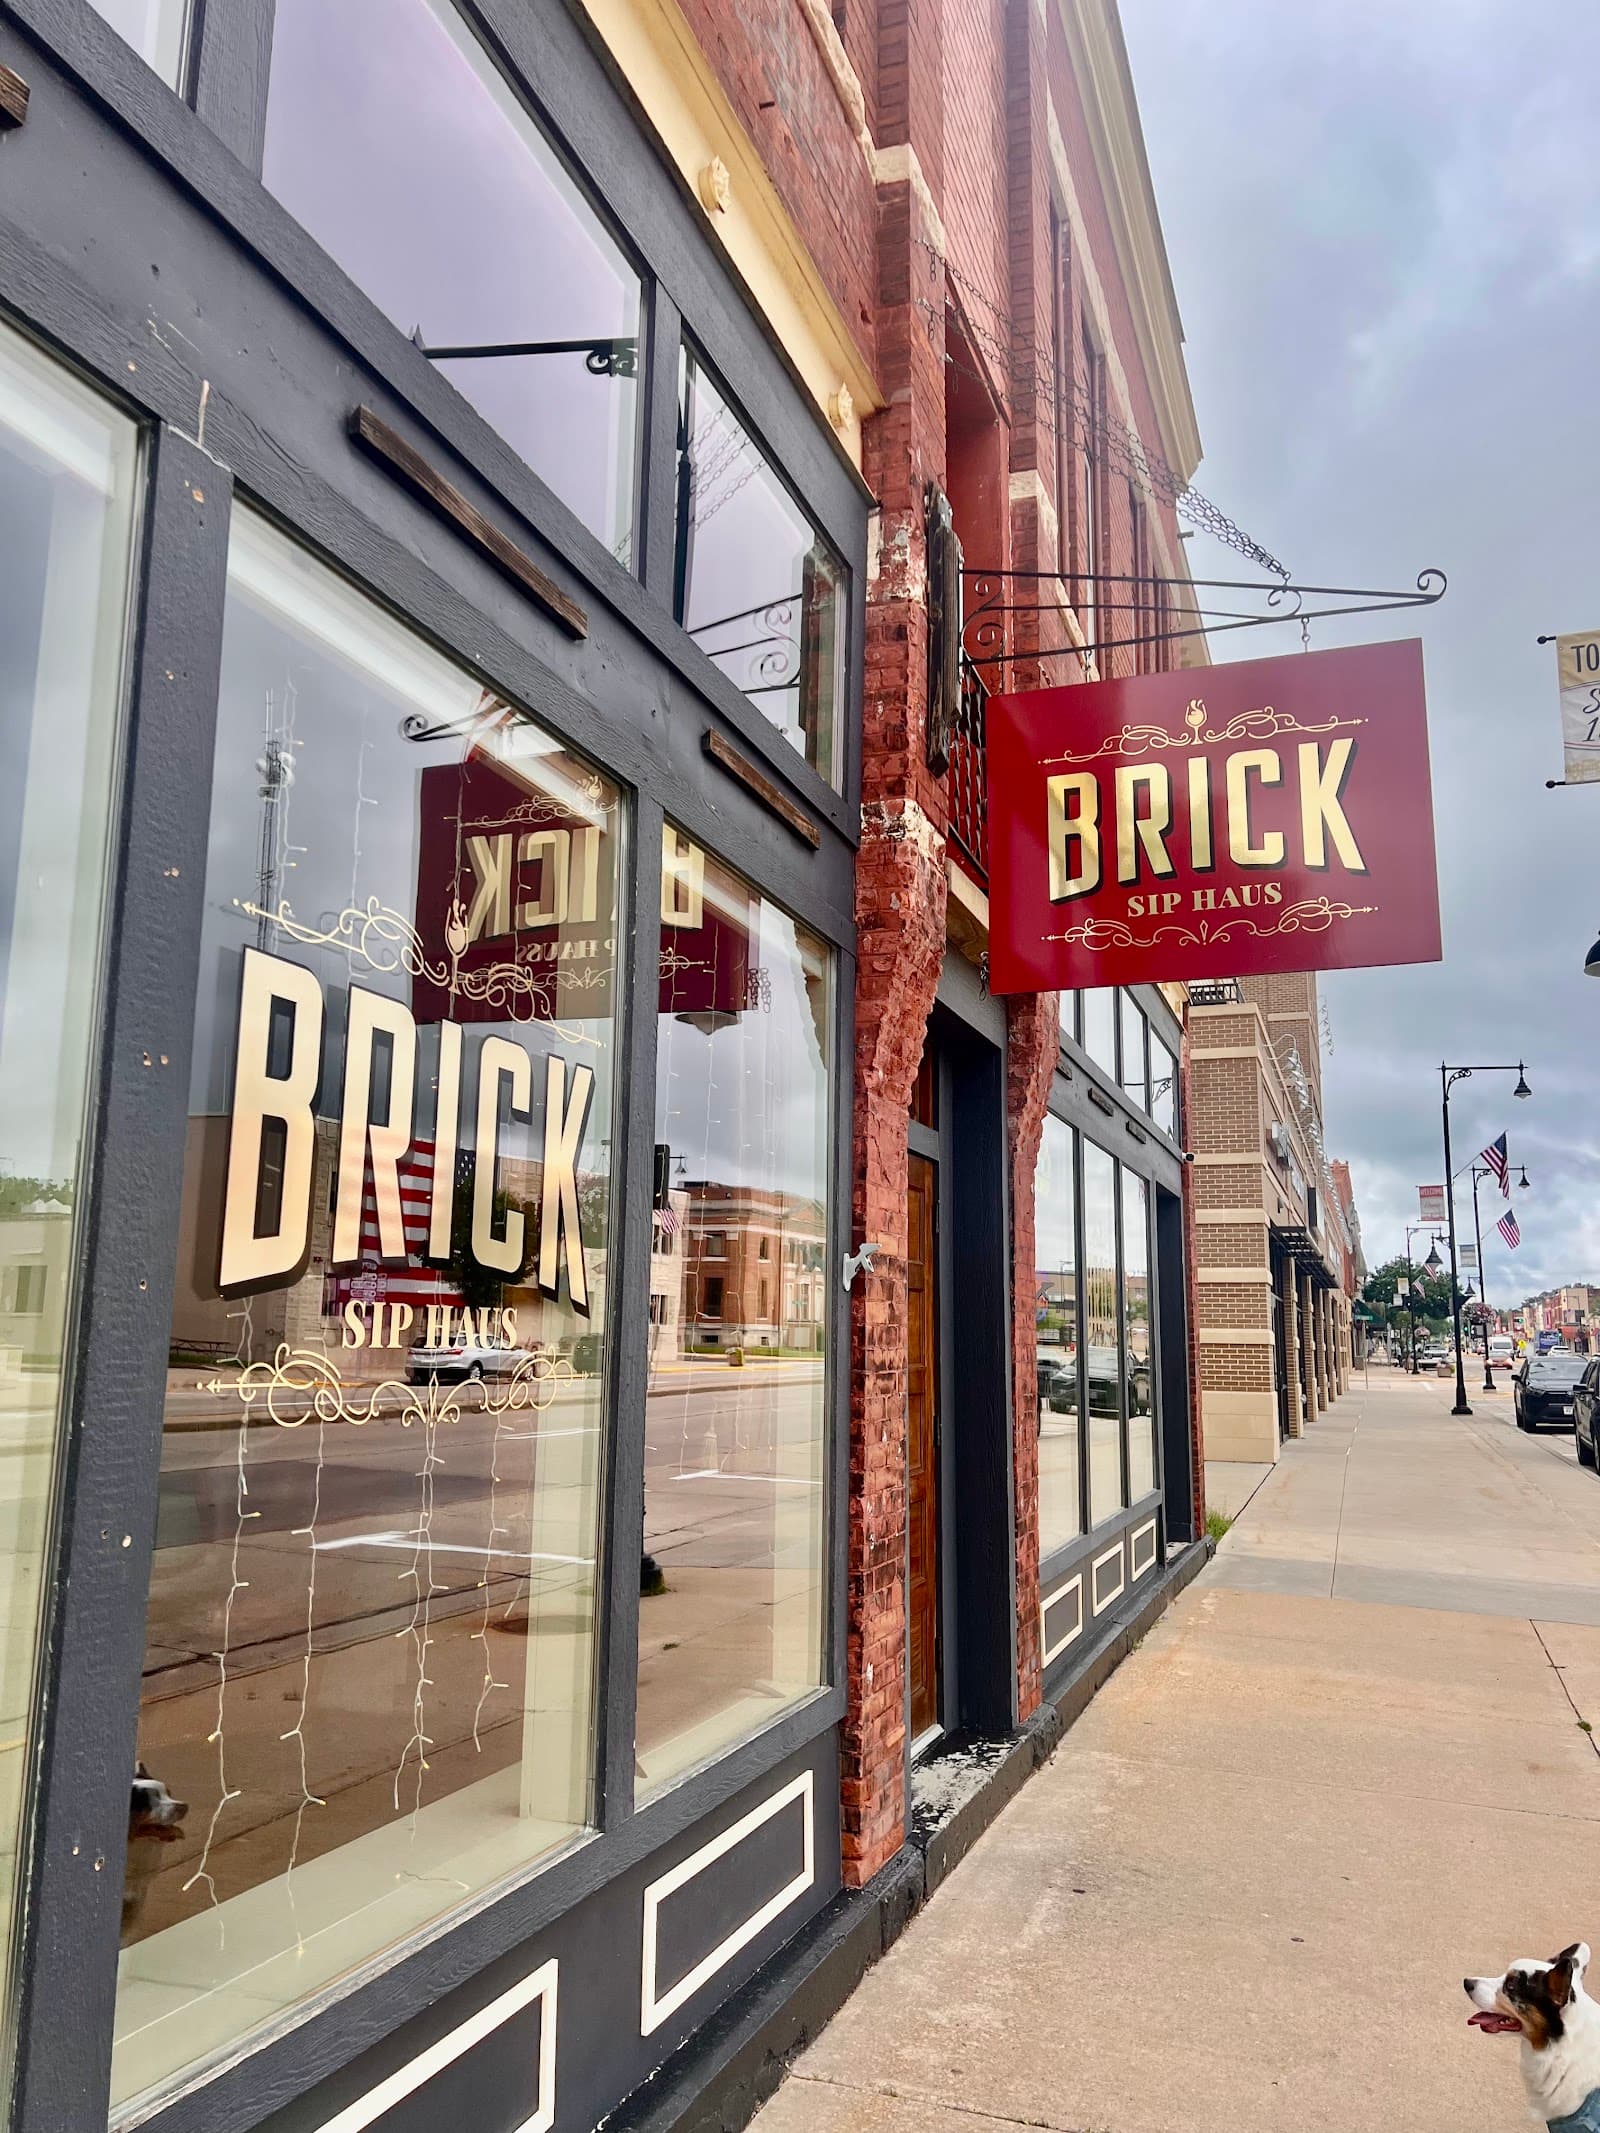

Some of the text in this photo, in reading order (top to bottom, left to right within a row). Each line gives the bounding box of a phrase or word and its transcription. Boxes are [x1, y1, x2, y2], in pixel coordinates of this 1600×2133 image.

[1047, 738, 1366, 904] BRICK
[1127, 882, 1283, 918] SIP HAUS
[218, 945, 594, 1317] BRICK
[342, 1300, 518, 1349] SIP HAUS
